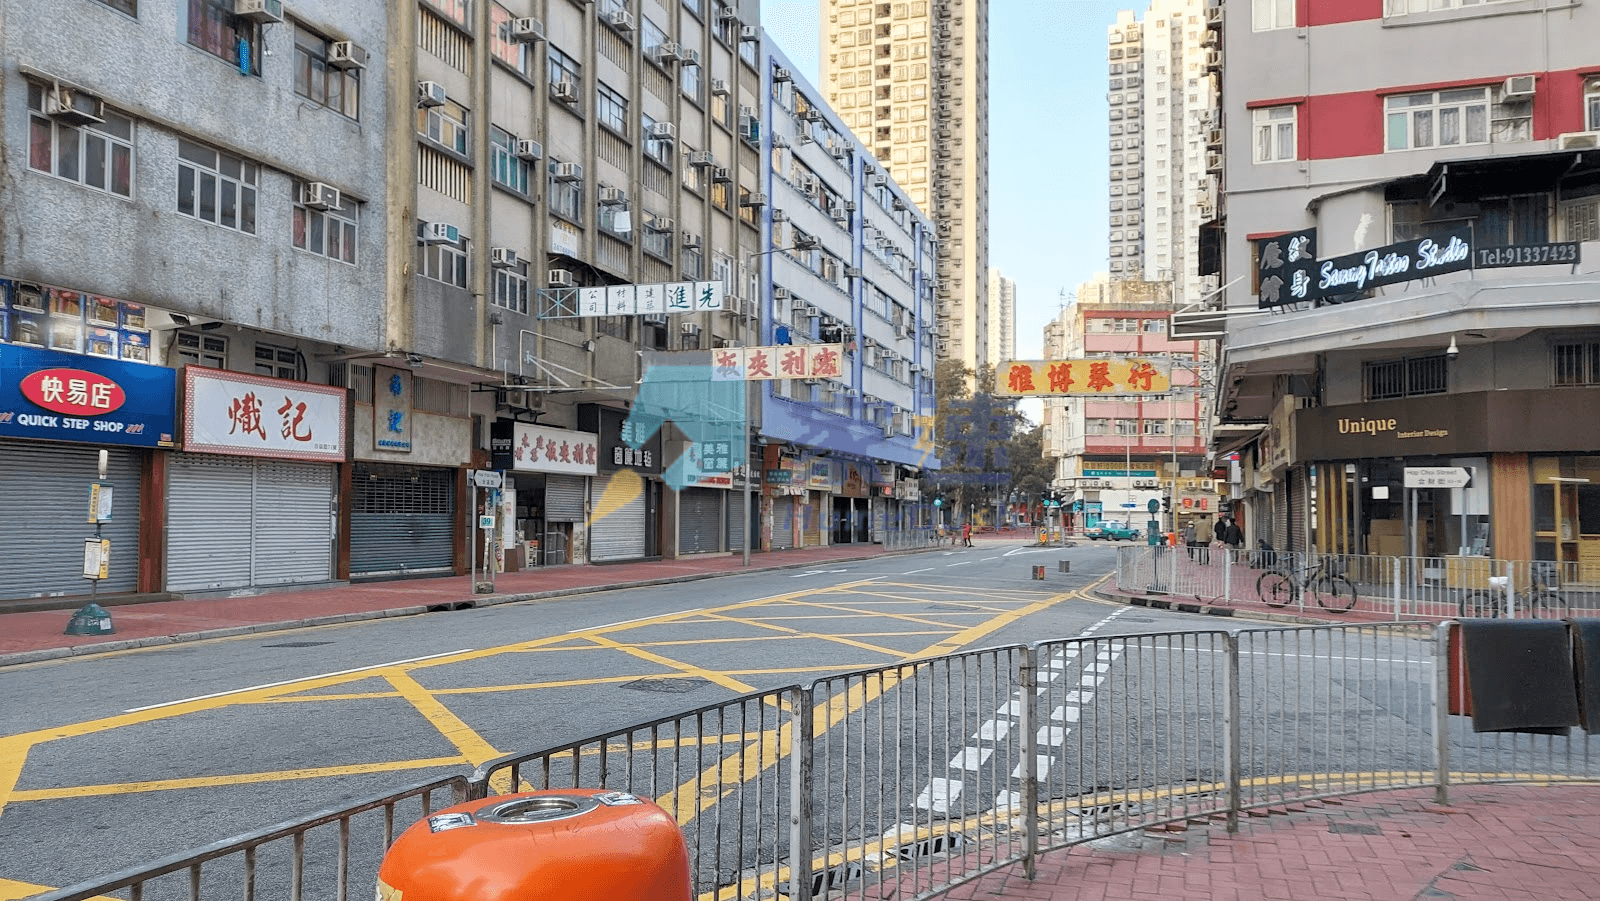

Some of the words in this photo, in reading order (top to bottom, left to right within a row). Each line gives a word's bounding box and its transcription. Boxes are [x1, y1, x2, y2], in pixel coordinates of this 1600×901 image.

[1415, 235, 1468, 269] Studio
[1479, 244, 1577, 266] Tel:91337423
[1008, 362, 1158, 393] 雅博琴行
[40, 375, 112, 409] 快易店
[16, 413, 58, 428] QUICK
[62, 417, 90, 430] STEP
[93, 420, 124, 433] SHOP
[228, 391, 313, 442] 熾記
[1338, 417, 1397, 436] Unique
[1397, 430, 1424, 439] Interior
[1424, 428, 1449, 438] Design
[482, 517, 492, 526] 39
